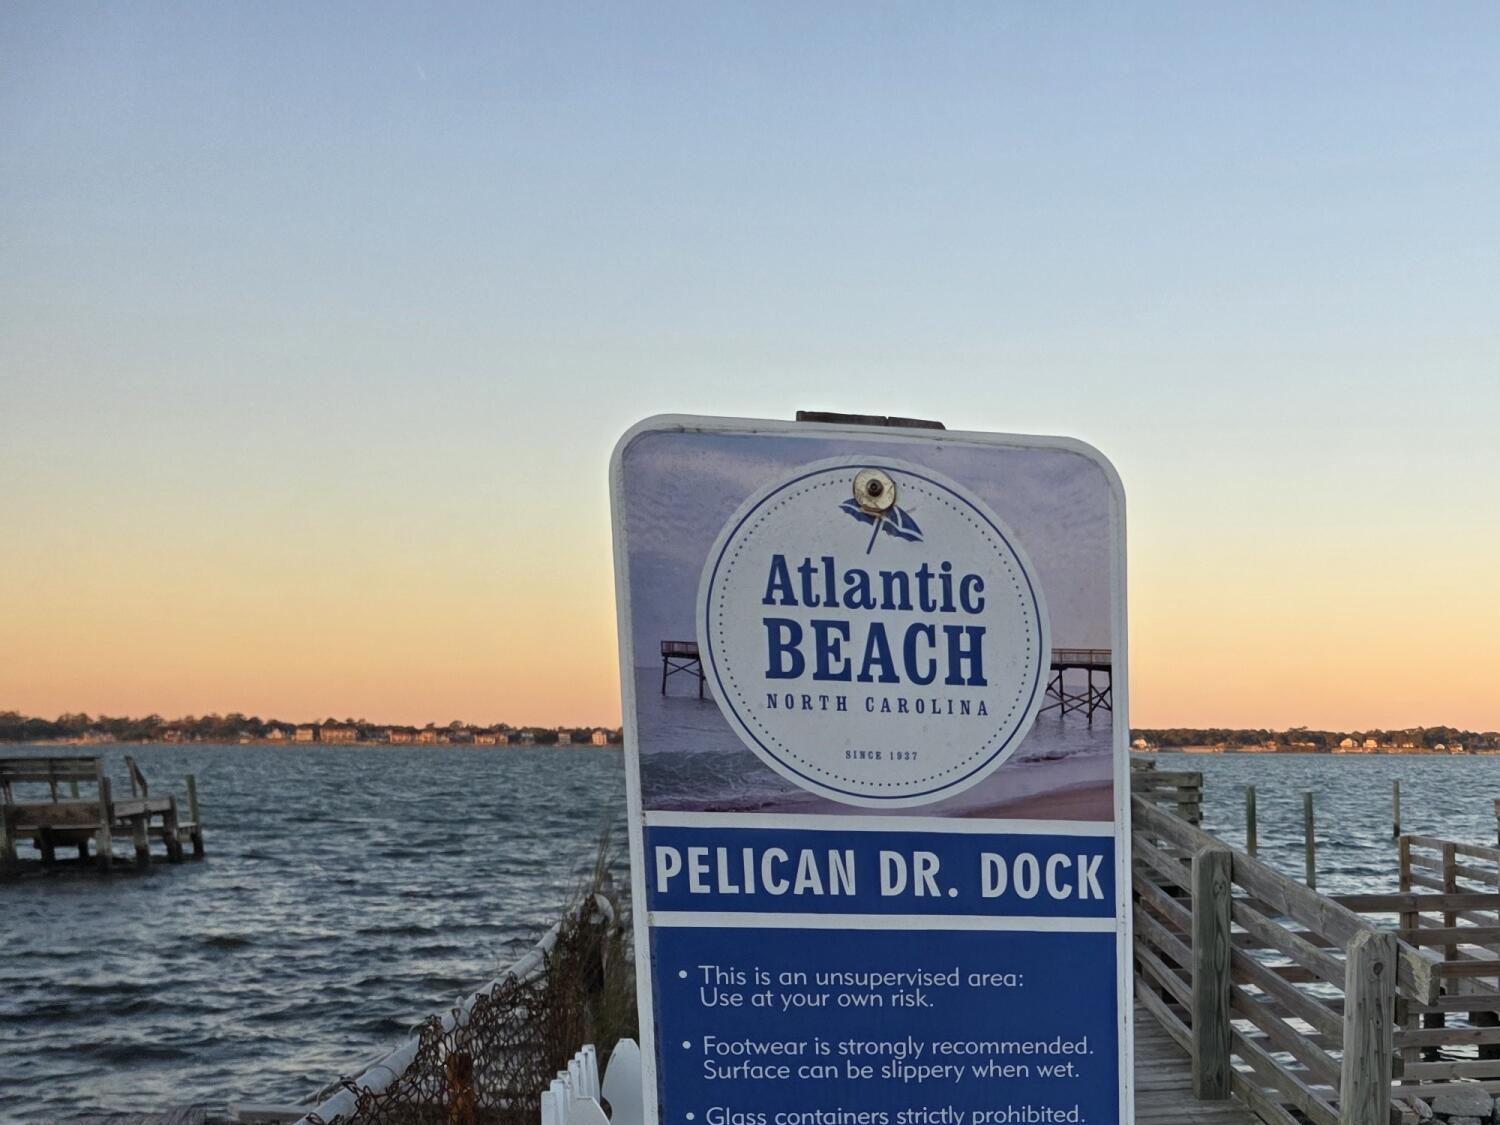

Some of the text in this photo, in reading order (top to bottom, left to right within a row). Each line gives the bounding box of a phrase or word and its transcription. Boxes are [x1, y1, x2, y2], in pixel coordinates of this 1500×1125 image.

[762, 554, 985, 614] Atlantic
[762, 617, 988, 687] BEACH
[767, 694, 988, 716] NORTH CAROLINA
[845, 750, 882, 760] SINCE
[655, 846, 1104, 900] PELICAN DR. DOCK
[699, 966, 1023, 993] This is an unsupervised area:
[700, 988, 934, 1012] Use at your own risk.
[704, 1036, 1093, 1060] Footwear is strongly recommended.
[704, 1060, 1080, 1084] Surface can be slippery when wet.
[774, 1106, 889, 1125] containers
